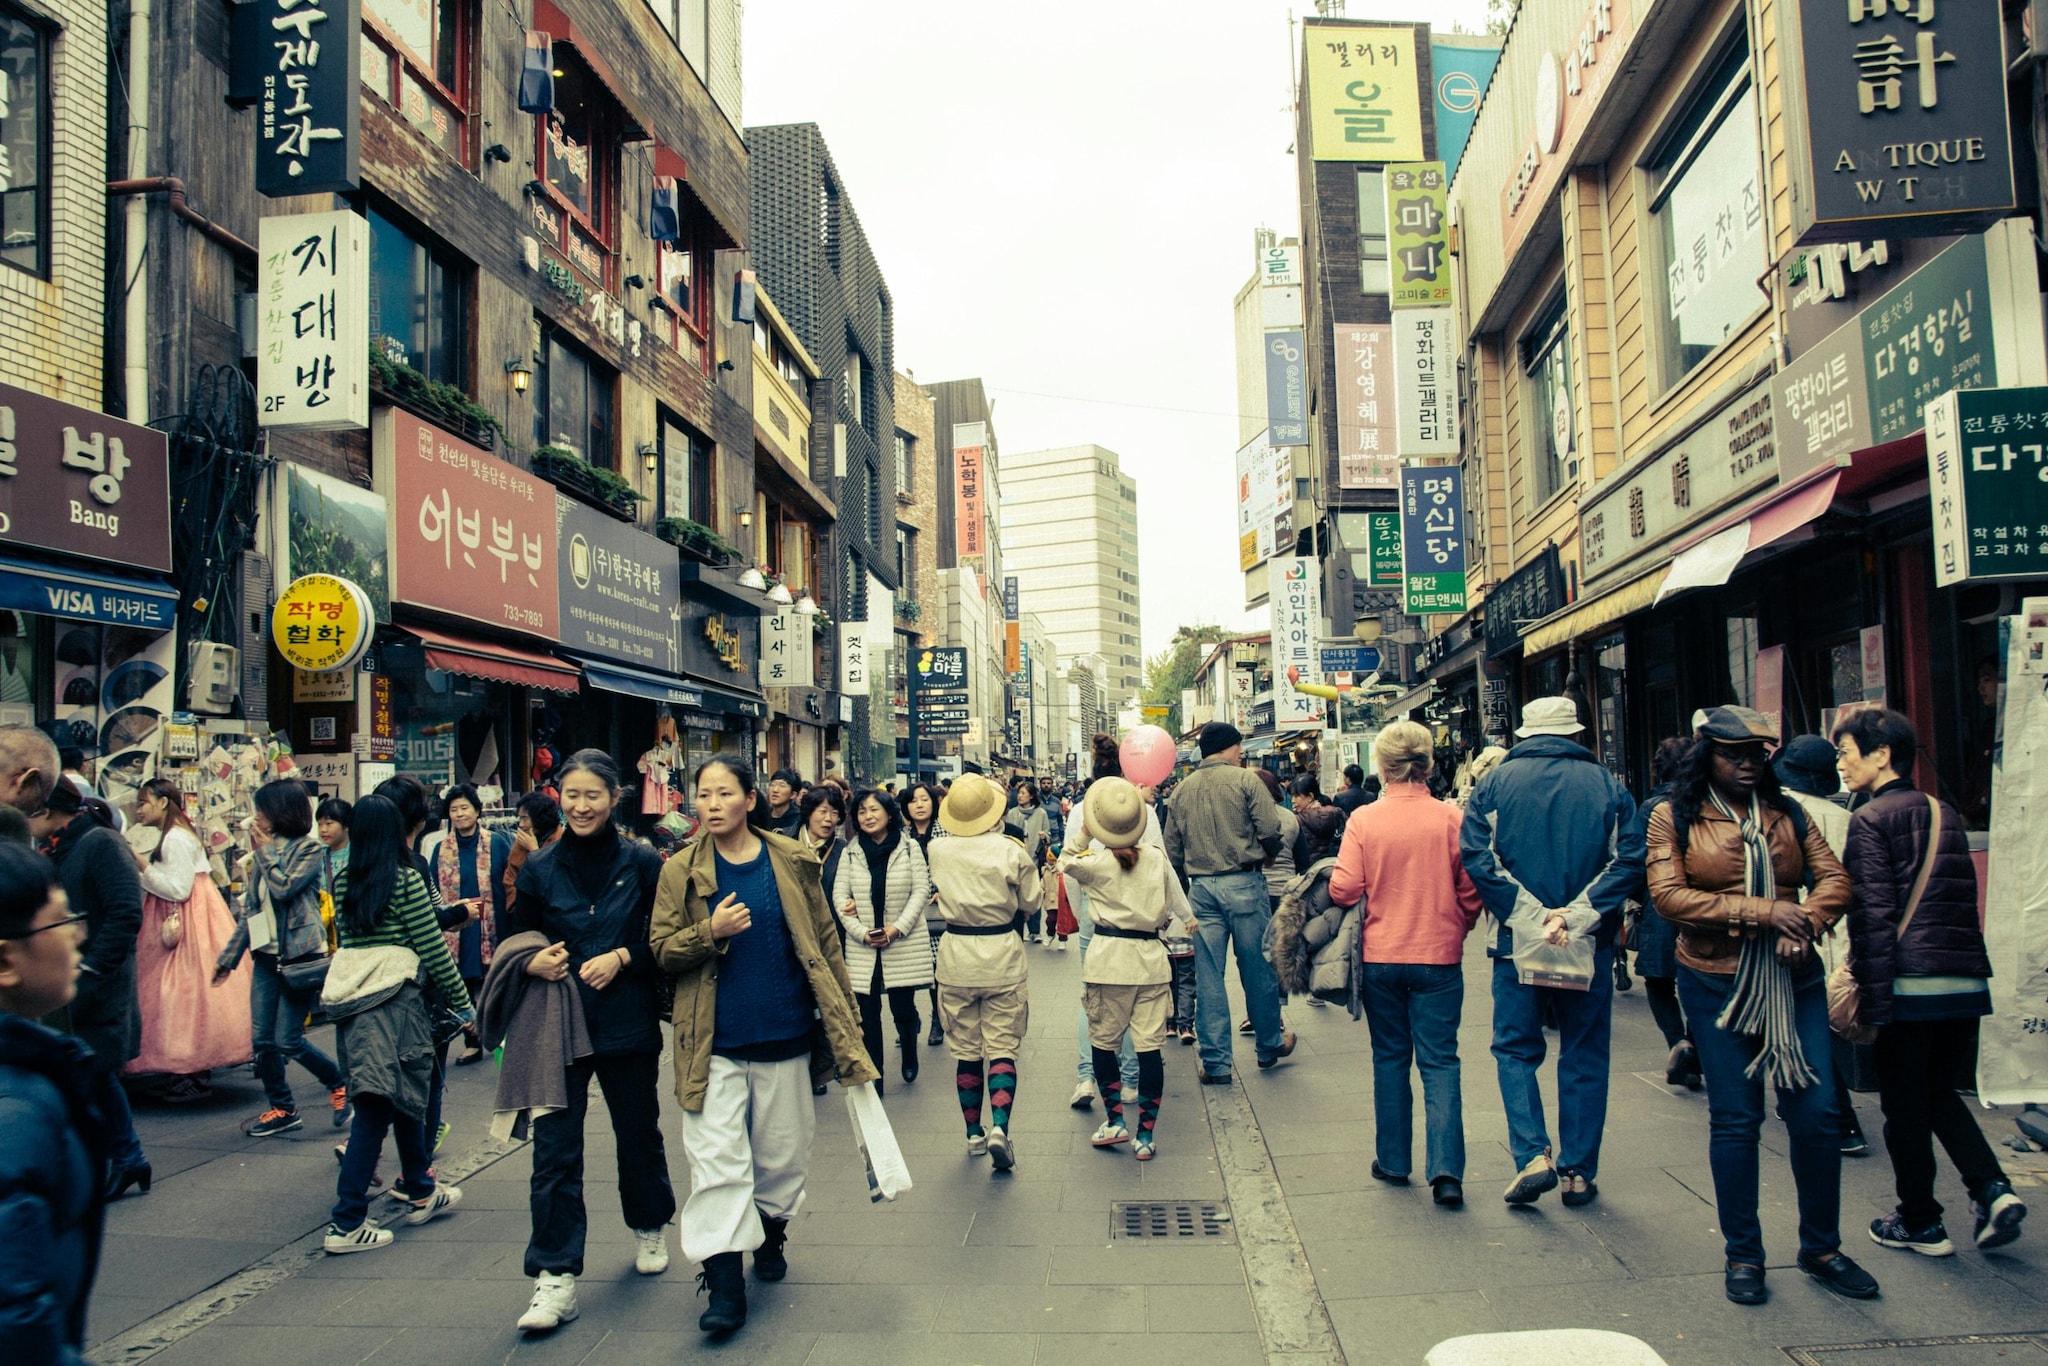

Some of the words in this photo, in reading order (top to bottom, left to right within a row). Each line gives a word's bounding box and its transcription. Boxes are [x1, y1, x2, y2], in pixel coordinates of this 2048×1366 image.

[1326, 41, 1399, 68] 갤러리
[263, 75, 276, 140] 인사동본점
[1392, 171, 1440, 188] 옥션
[1401, 201, 1436, 275] 마니
[1670, 178, 1762, 313] 전통찻집
[266, 249, 287, 365] 전통찻집
[1395, 289, 1430, 301] 고미술
[1433, 288, 1449, 299] 2F
[291, 224, 338, 409] 지대방
[1868, 291, 1914, 340] 전통찻집
[1350, 332, 1379, 344] 제2회
[1874, 288, 1973, 380] 다경향실
[1286, 365, 1302, 420] GALLERY
[1415, 319, 1438, 441] 평화아트갤러리
[1783, 351, 1850, 421] 평화아트
[264, 395, 287, 413] 2F
[1802, 391, 1854, 456] 갤러리
[62, 426, 132, 505] 방
[438, 442, 469, 473] 천연의
[960, 454, 978, 499] 노학봉
[1406, 478, 1418, 516] 도서출판
[69, 499, 120, 537] Bang
[1422, 476, 1460, 565] 명신당
[1972, 525, 2029, 539] 작설차
[1973, 542, 2030, 557] 모과차
[592, 544, 662, 597] (주)한국공예관
[1409, 576, 1437, 591] 월간
[46, 585, 96, 616] VISA
[101, 595, 163, 622] 비자카드
[287, 601, 344, 621] 작명
[502, 603, 544, 628] 733-7893
[1277, 599, 1286, 633] INSA
[1410, 593, 1464, 608] 아트앤씨
[286, 624, 346, 647] 철학
[769, 615, 787, 679] 인사동
[1278, 638, 1288, 663] ART
[1286, 581, 1312, 714] (주)인사아트프자
[365, 657, 375, 666] 33
[847, 634, 863, 684] 옛찻집
[933, 661, 963, 681] 마루
[936, 651, 961, 663] 인사동
[1321, 649, 1357, 659] 인사동8길
[1236, 678, 1249, 692] 꽃
[1279, 665, 1289, 705] PLAZA
